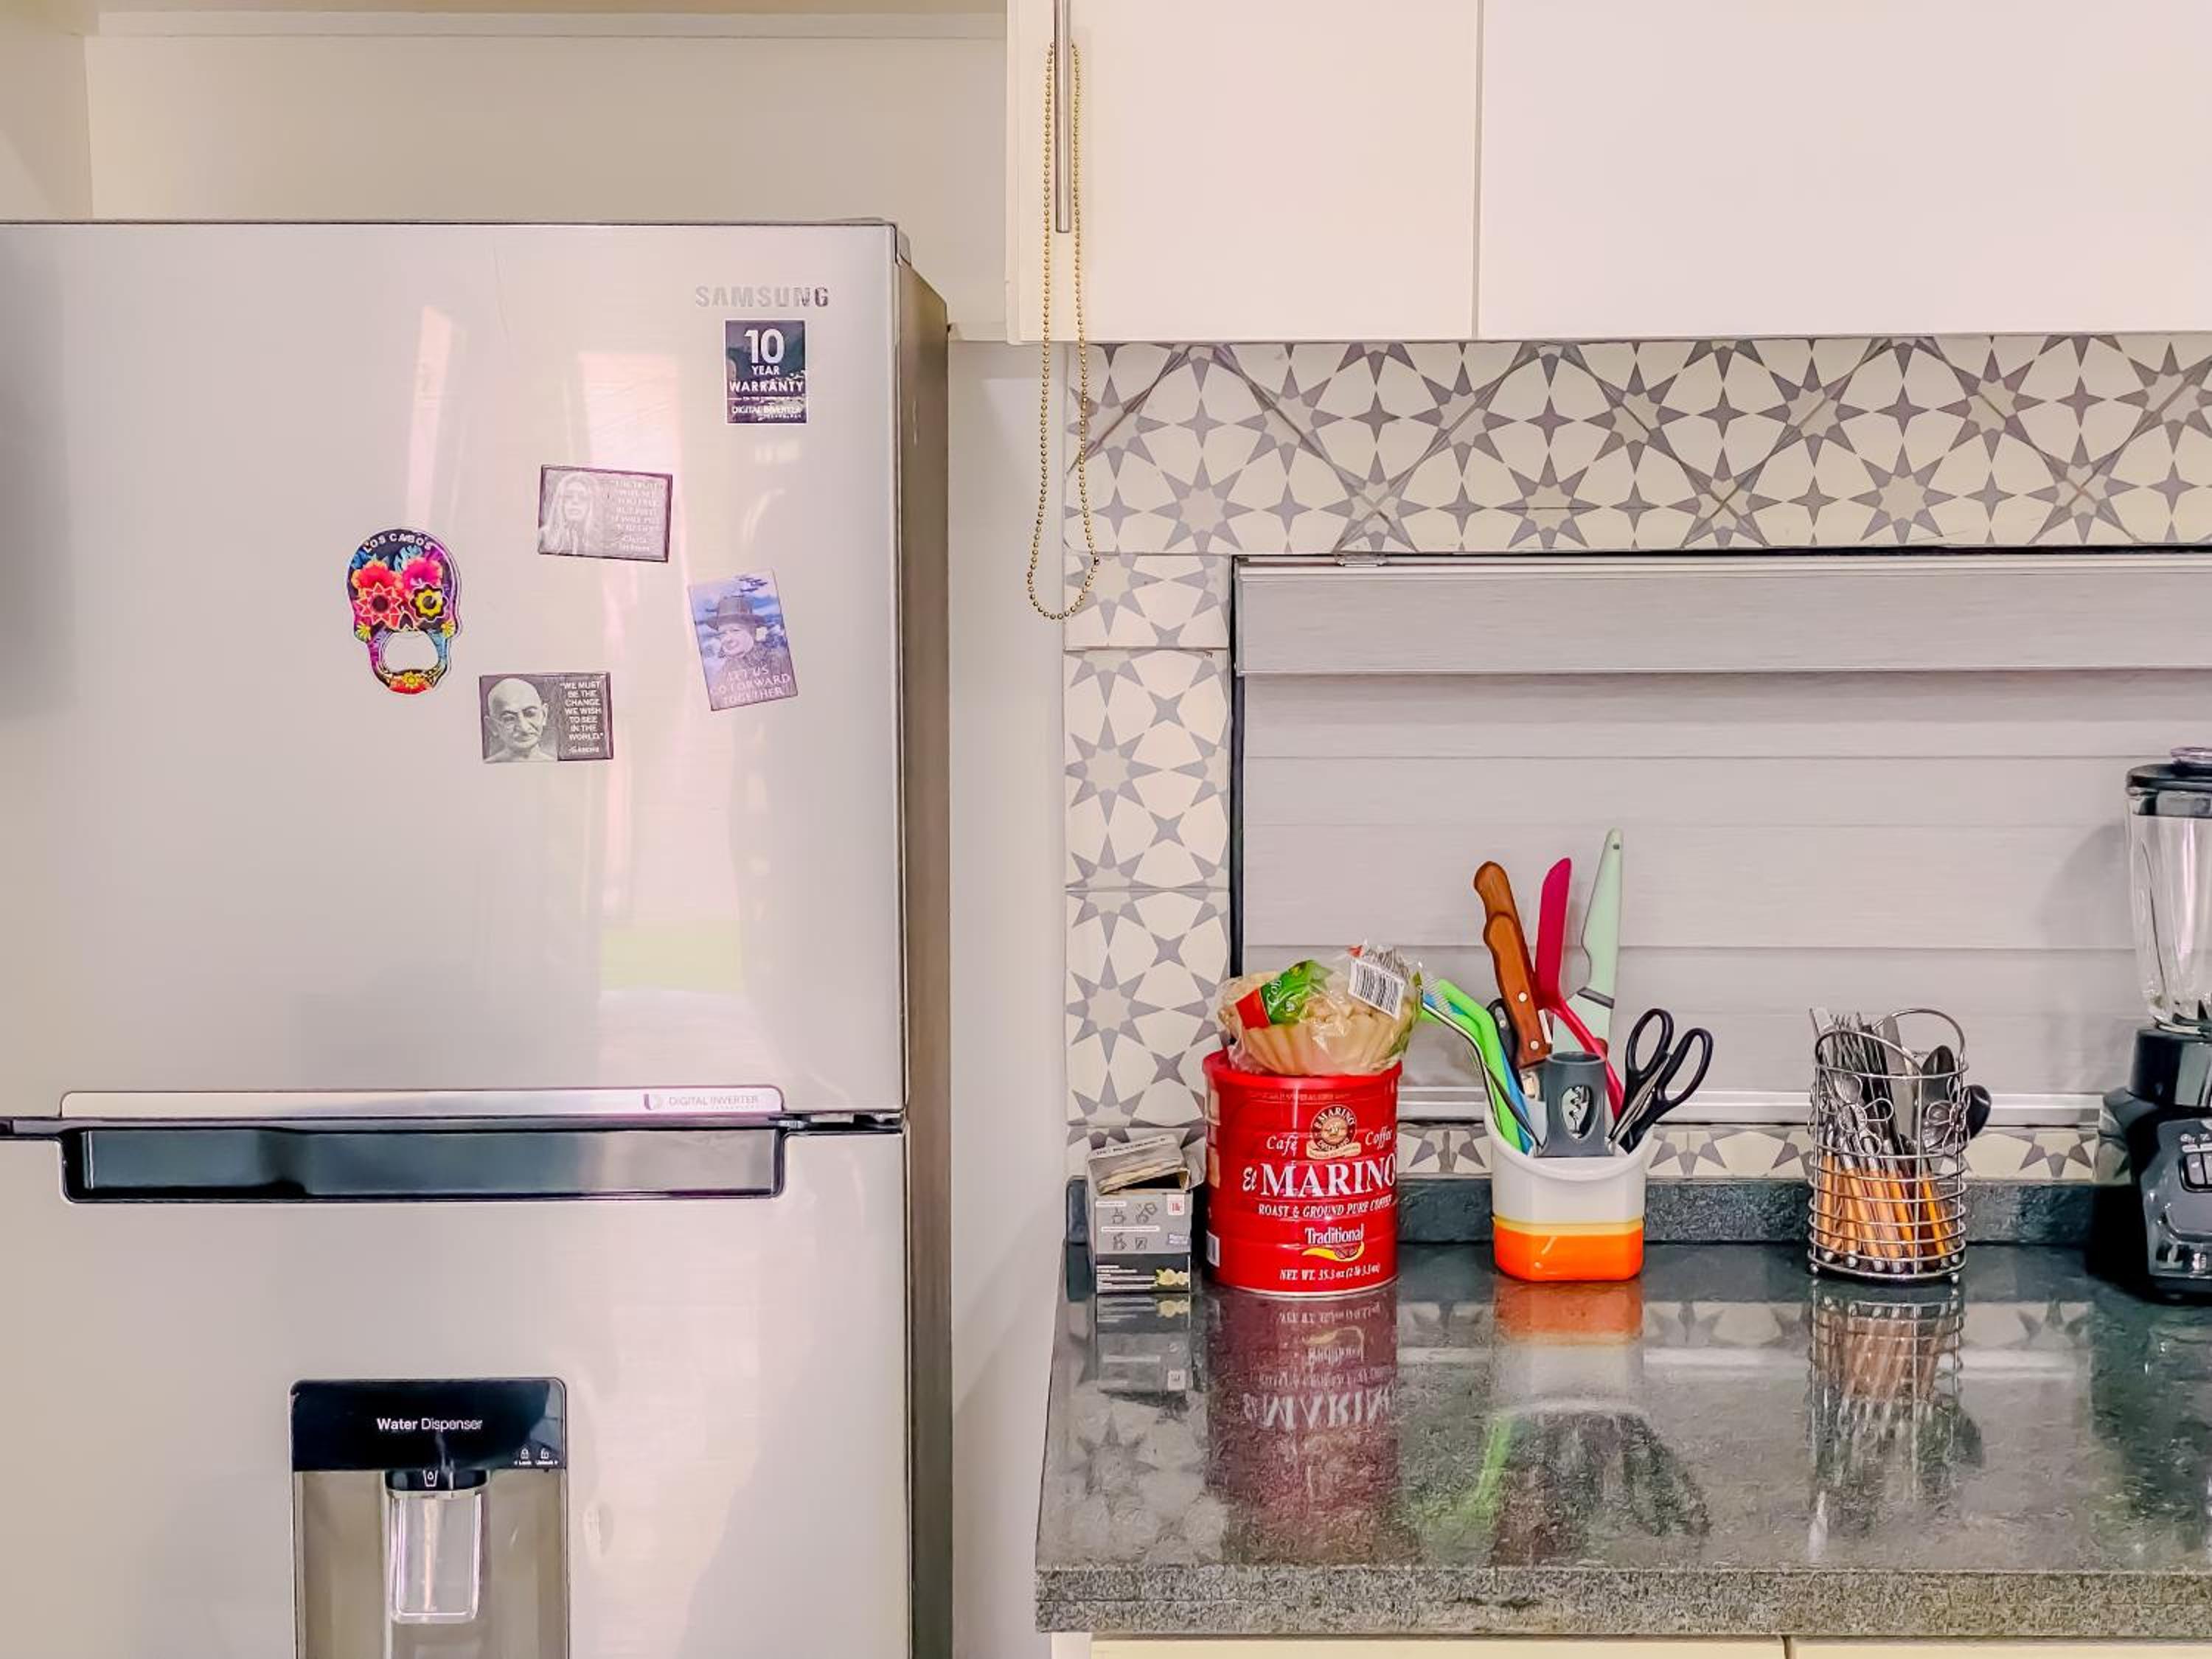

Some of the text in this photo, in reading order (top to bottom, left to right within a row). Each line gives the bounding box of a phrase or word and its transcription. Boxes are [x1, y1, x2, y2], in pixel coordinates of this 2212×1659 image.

[695, 285, 829, 307] SAMSUNG
[744, 328, 785, 364] 10
[751, 365, 780, 375] YEAR
[729, 380, 803, 392] WARRANTY
[363, 533, 432, 552] LOS CABOS
[578, 681, 601, 689] MUST
[581, 689, 597, 698] THE
[565, 698, 601, 706] CHANGE
[565, 707, 578, 715] WE
[1259, 1152, 1397, 1198] MARINO
[1259, 1203, 1289, 1217] ROAST
[1293, 1206, 1300, 1218] &
[1303, 1203, 1344, 1217] GROUND
[1304, 1223, 1363, 1245] Traditional
[1279, 1269, 1298, 1281] NET
[377, 1417, 483, 1433] Water Dispenser
